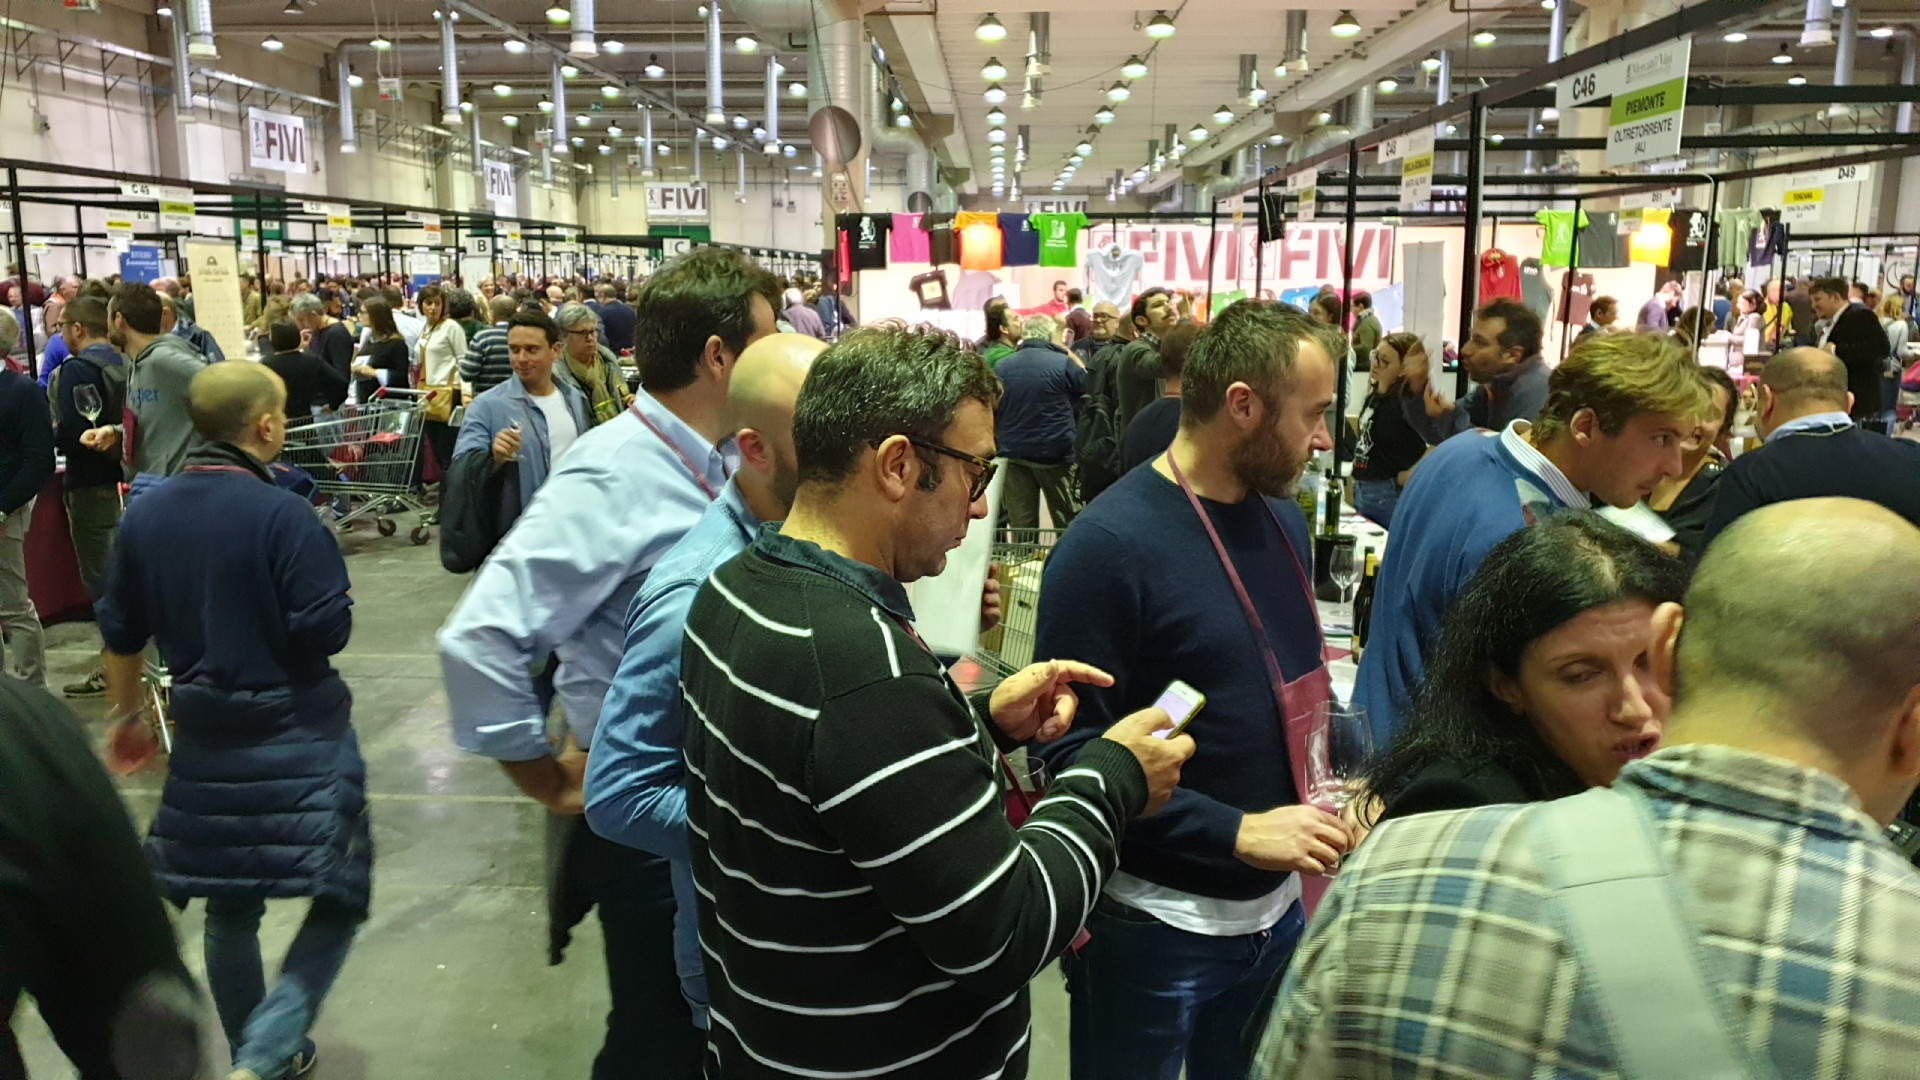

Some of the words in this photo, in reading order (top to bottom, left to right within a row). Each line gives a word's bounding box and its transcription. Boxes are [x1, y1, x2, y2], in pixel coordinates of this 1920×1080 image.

[1572, 73, 1596, 100] C46
[1625, 90, 1666, 116] PIEMONTE
[264, 120, 305, 163] FIVI
[1614, 117, 1673, 144] OLTRETORRENTE
[490, 166, 512, 197] FIVI
[1838, 164, 1856, 180] D49
[661, 188, 706, 210] FIVI
[478, 240, 487, 252] B
[674, 241, 685, 254] C
[1129, 231, 1238, 281] FIVI
[1279, 229, 1392, 279] FIVI
